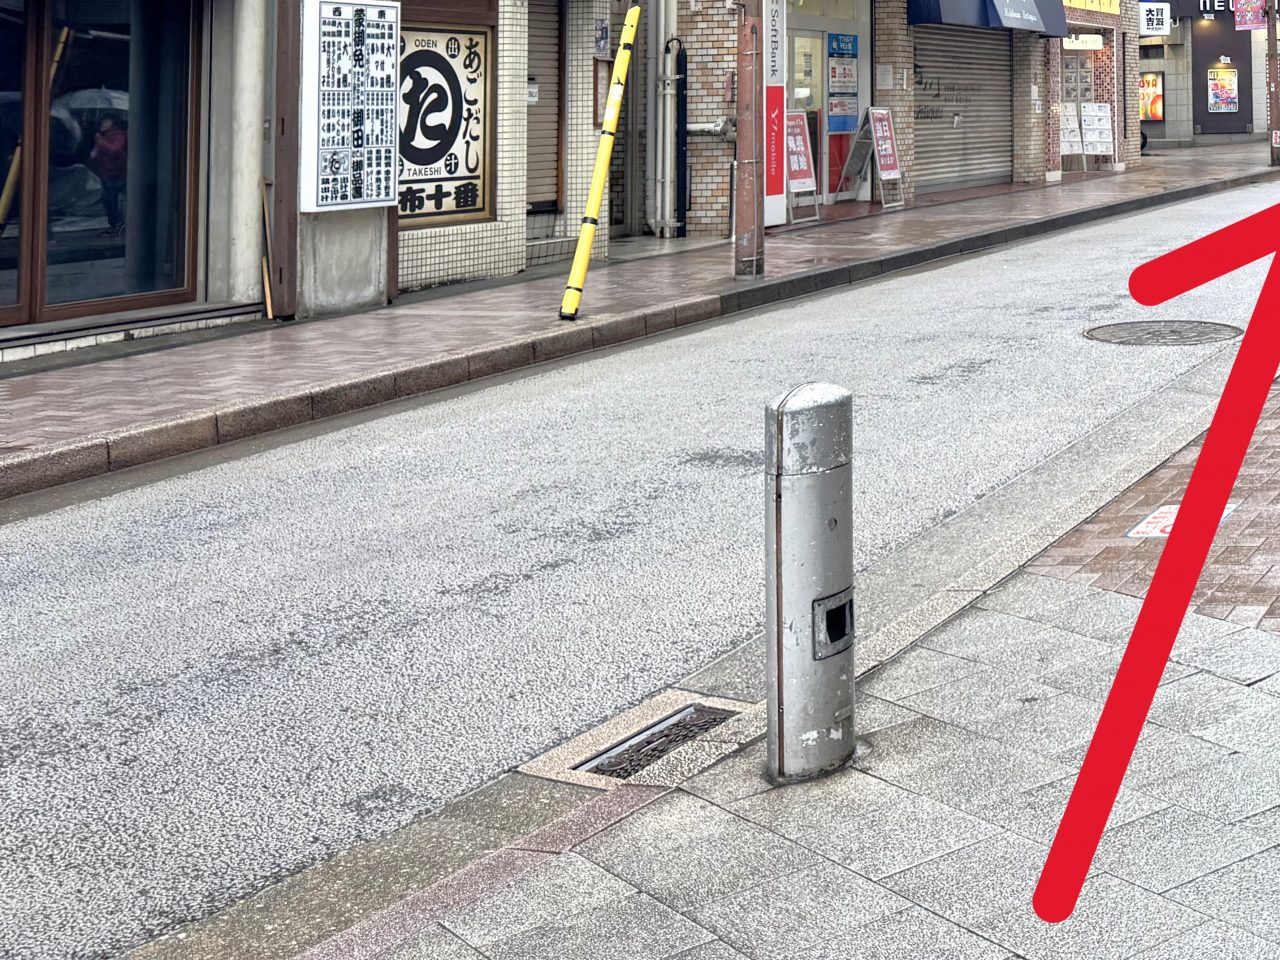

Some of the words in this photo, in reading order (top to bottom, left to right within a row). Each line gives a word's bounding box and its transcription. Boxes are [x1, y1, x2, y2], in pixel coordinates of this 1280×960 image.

[414, 39, 437, 49] ODEN
[770, 8, 779, 78] SoftBank
[463, 38, 482, 173] あごだし
[407, 167, 441, 177] TAKESHI
